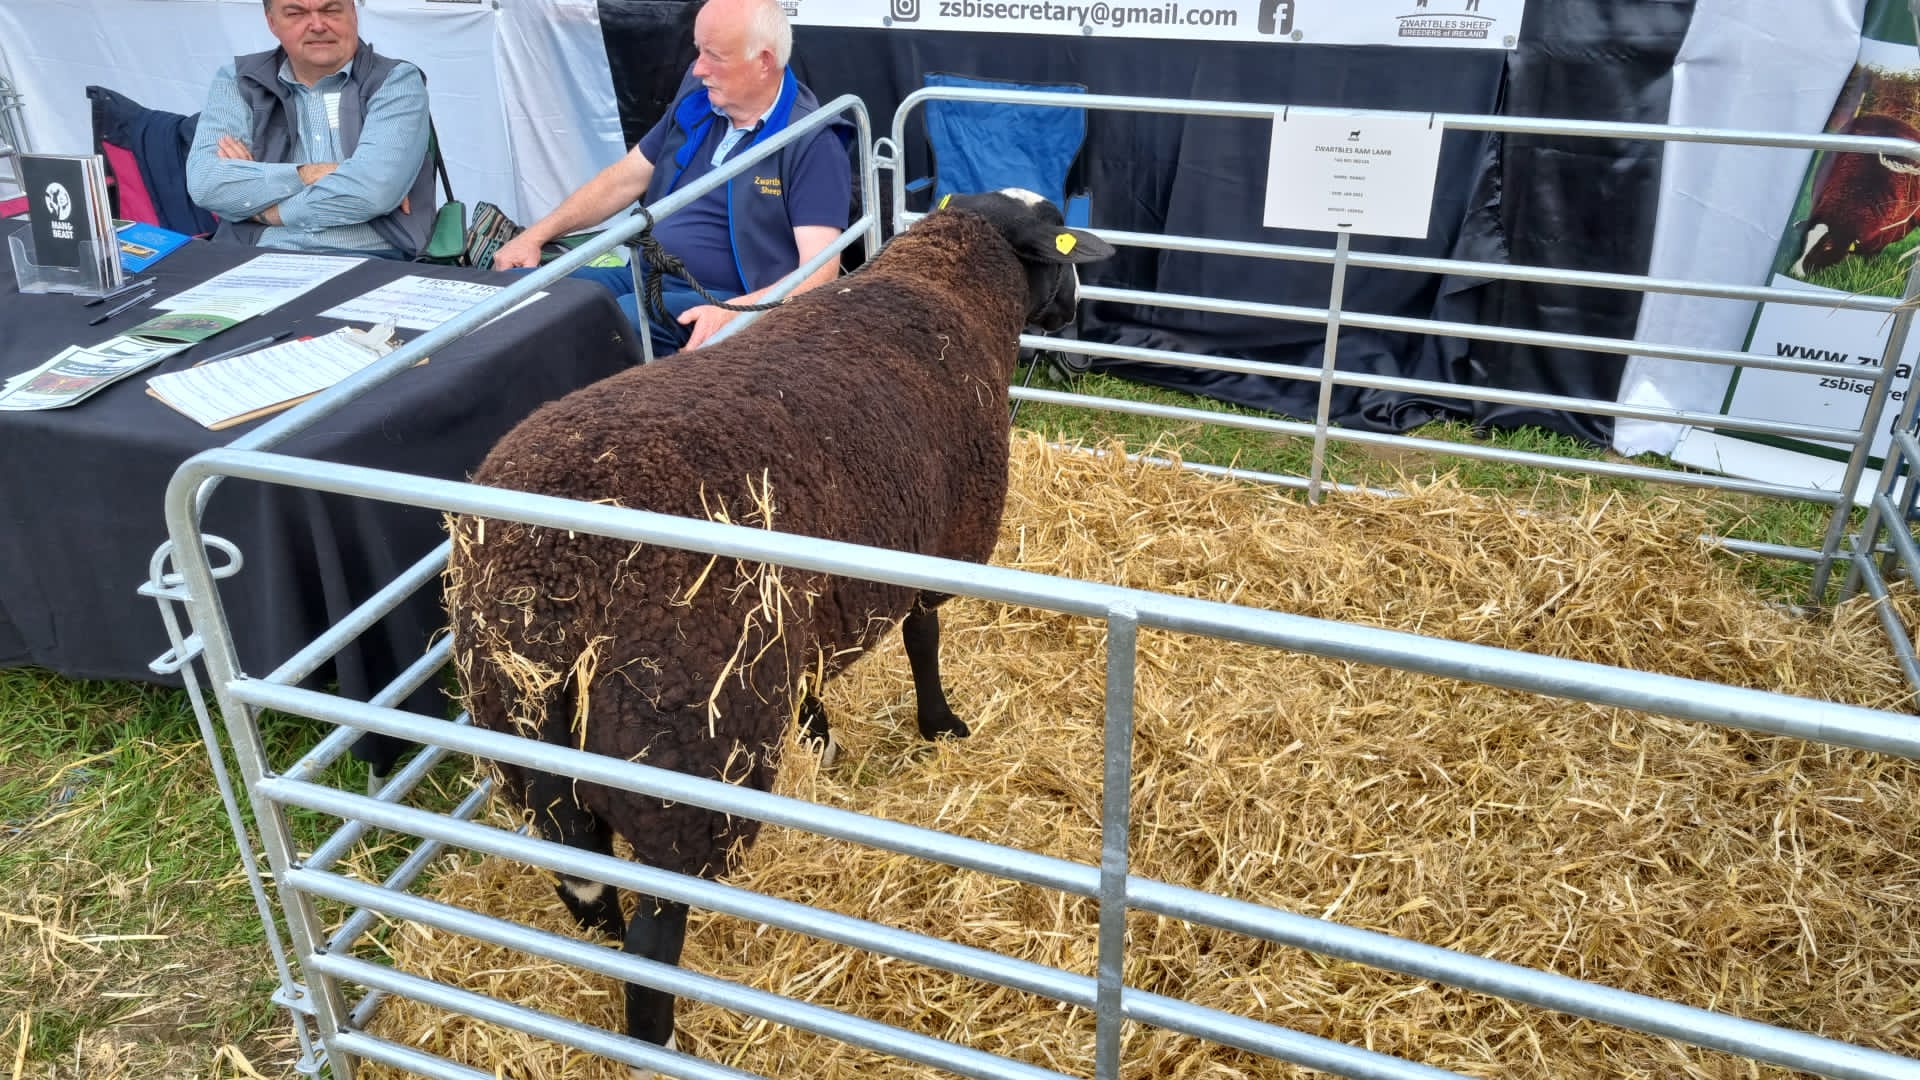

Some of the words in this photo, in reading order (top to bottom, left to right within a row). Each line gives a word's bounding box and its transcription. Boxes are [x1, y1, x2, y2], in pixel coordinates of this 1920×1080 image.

[939, 0, 1237, 28] zsbisecretary@gmail.com
[1400, 20, 1457, 29] ZWARTBLES
[1460, 21, 1492, 29] SHEEP
[1402, 29, 1442, 37] BREEDERS
[1314, 145, 1353, 154] ZWARTBLES
[52, 229, 75, 239] BEAST
